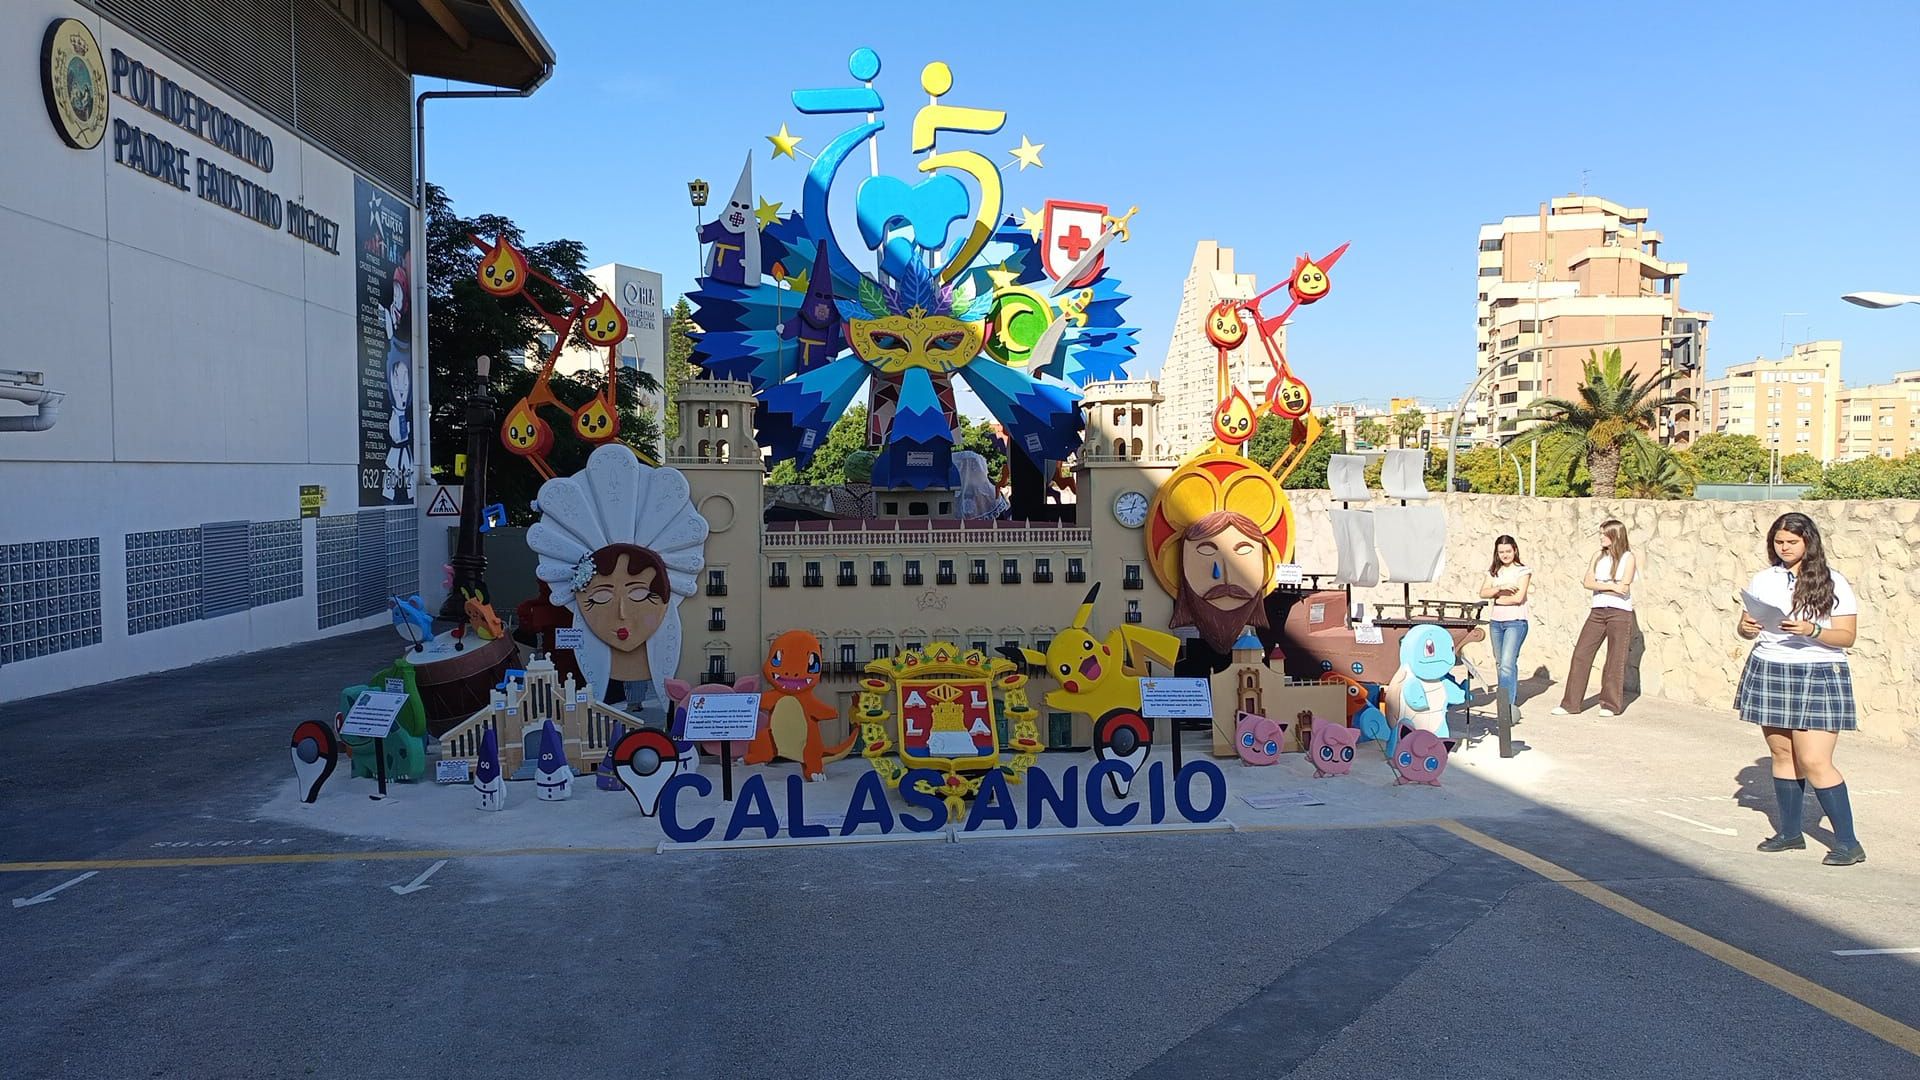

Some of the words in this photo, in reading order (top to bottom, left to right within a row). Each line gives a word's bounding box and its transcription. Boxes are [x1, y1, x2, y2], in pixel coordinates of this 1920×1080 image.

[111, 48, 274, 173] POLIDEPORTIVO
[114, 118, 191, 192] PADRE
[197, 157, 283, 230] FAUSTINO
[362, 468, 379, 489] 632
[904, 690, 926, 708] A
[970, 690, 988, 709] L
[905, 718, 923, 736] L
[968, 717, 991, 736] A
[658, 758, 1227, 843] CALASANCIO
